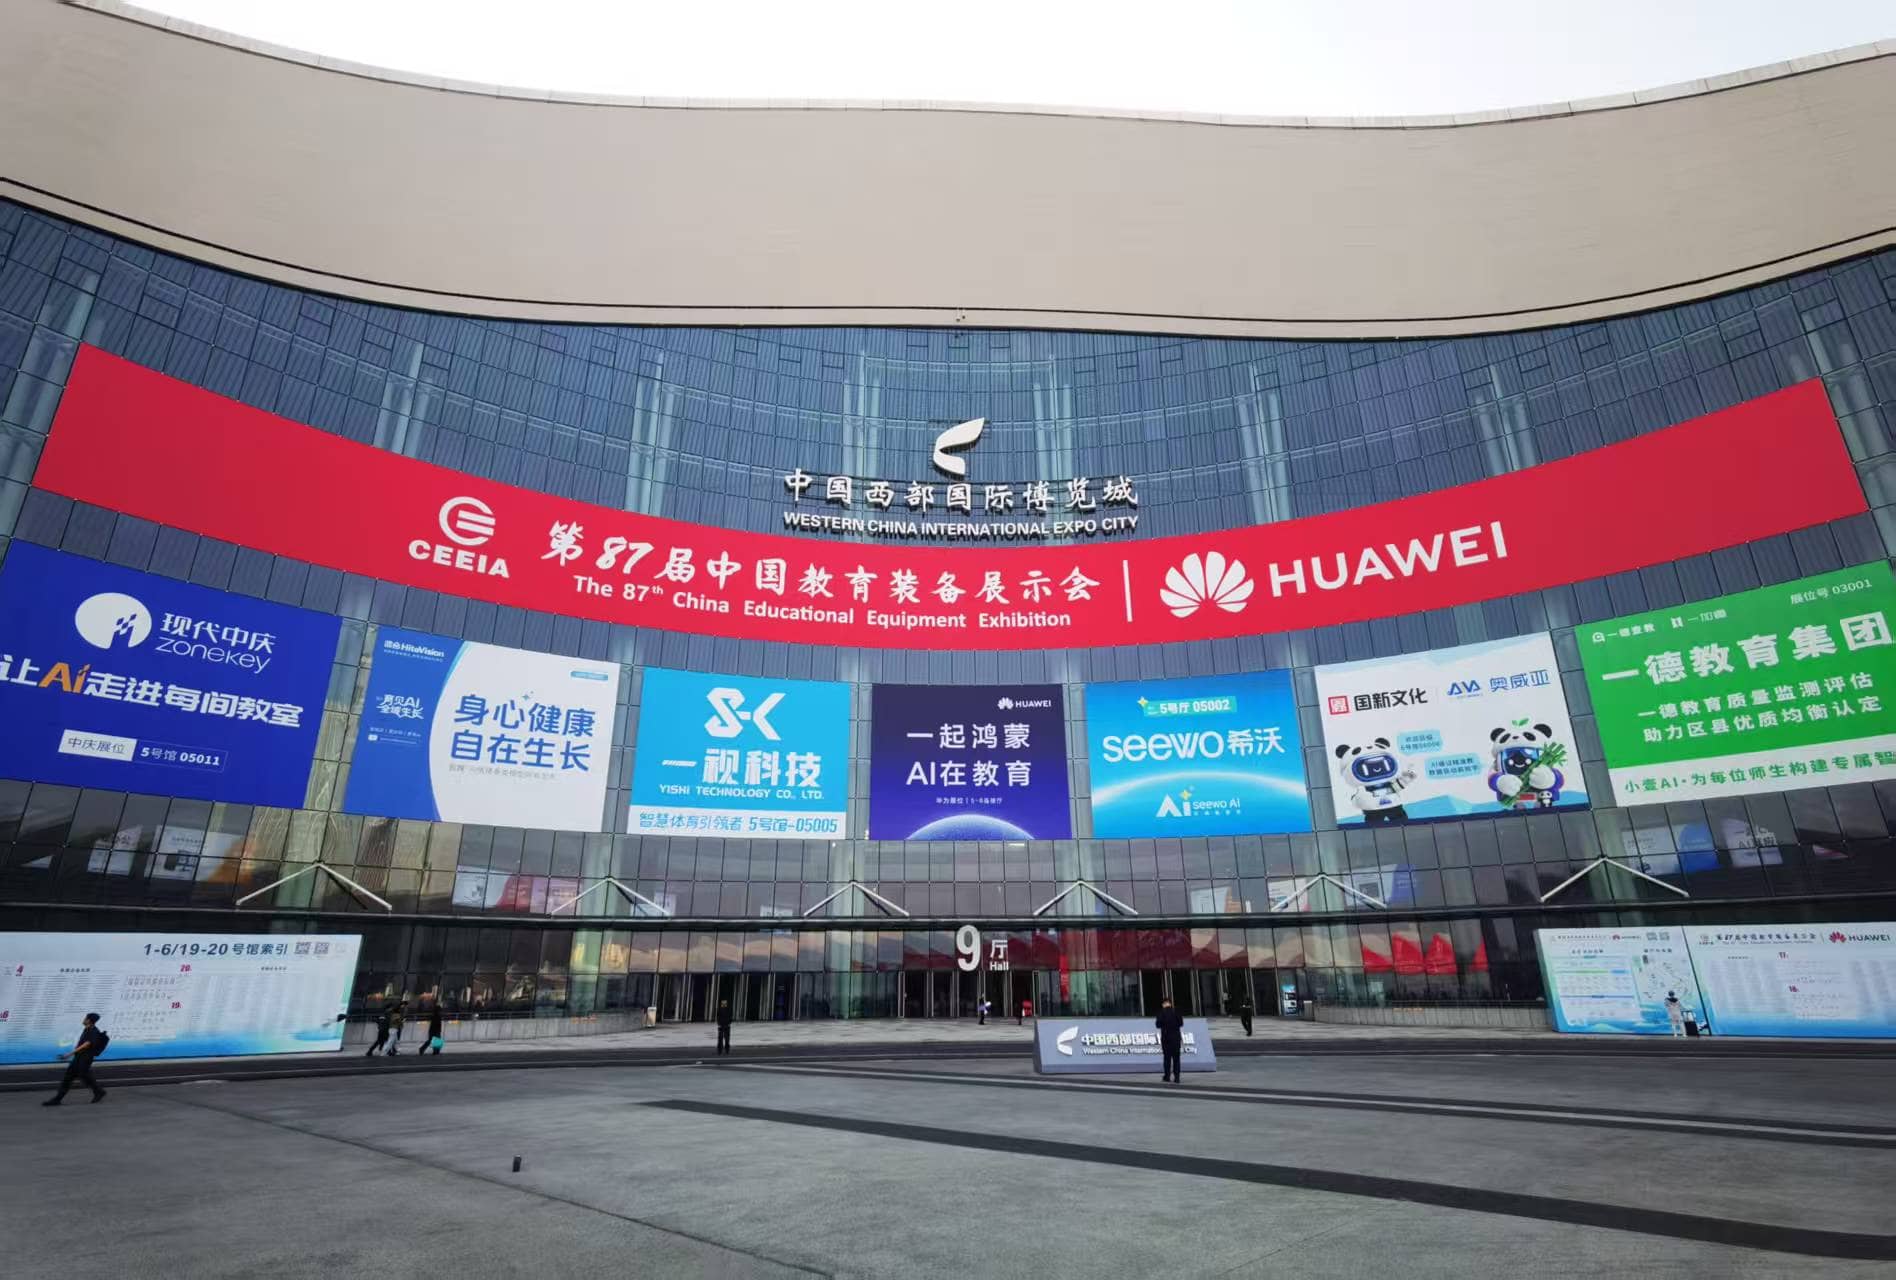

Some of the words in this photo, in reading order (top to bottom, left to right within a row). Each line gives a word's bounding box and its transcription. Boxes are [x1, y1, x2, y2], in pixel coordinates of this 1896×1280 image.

[784, 468, 1138, 513] 中国西部国际博览城
[784, 512, 864, 531] WESTERN
[868, 520, 917, 535] CHINA
[921, 521, 1049, 537] INTERNATIONAL
[1054, 519, 1097, 534] EXPO
[1102, 515, 1138, 531] CITY
[408, 539, 510, 579] CEEIA
[541, 520, 1100, 605] 第87届中国教育装备展示会
[1269, 521, 1508, 598] HUAWEI
[573, 575, 613, 597] The
[623, 582, 664, 602] 87th
[673, 591, 730, 614] China
[744, 600, 854, 625] Educational
[867, 609, 966, 632] Equipment
[979, 612, 1071, 628] Exhibition
[1832, 579, 1872, 594] 03001
[160, 612, 276, 654] 现代中庆
[1602, 611, 1892, 685] 一德教育集团
[1489, 669, 1550, 692] 奥威亚
[1638, 672, 1874, 720] 一德教育质量监测评估
[453, 694, 596, 738] 身心健康
[1015, 699, 1051, 708] HUAWEI
[1354, 687, 1428, 711] 国新文化
[906, 723, 1030, 749] 一起鸿蒙
[1643, 696, 1882, 743] 助力区县优质均衡认定
[67, 736, 125, 755] 中庆展位
[179, 751, 220, 766] 05011
[450, 729, 590, 772] 自在生长
[661, 748, 822, 787] 一视科技
[906, 760, 1031, 787] AI在教育
[659, 784, 690, 795] YISHI
[696, 786, 770, 798] TECHNOLOGY
[639, 813, 743, 831] 智慧体育引领者
[143, 943, 228, 956] 1-6/19-20
[232, 943, 288, 955] 号馆索引
[956, 925, 981, 972] 9
[990, 939, 1009, 960] 厅
[990, 961, 1009, 971] Hall
